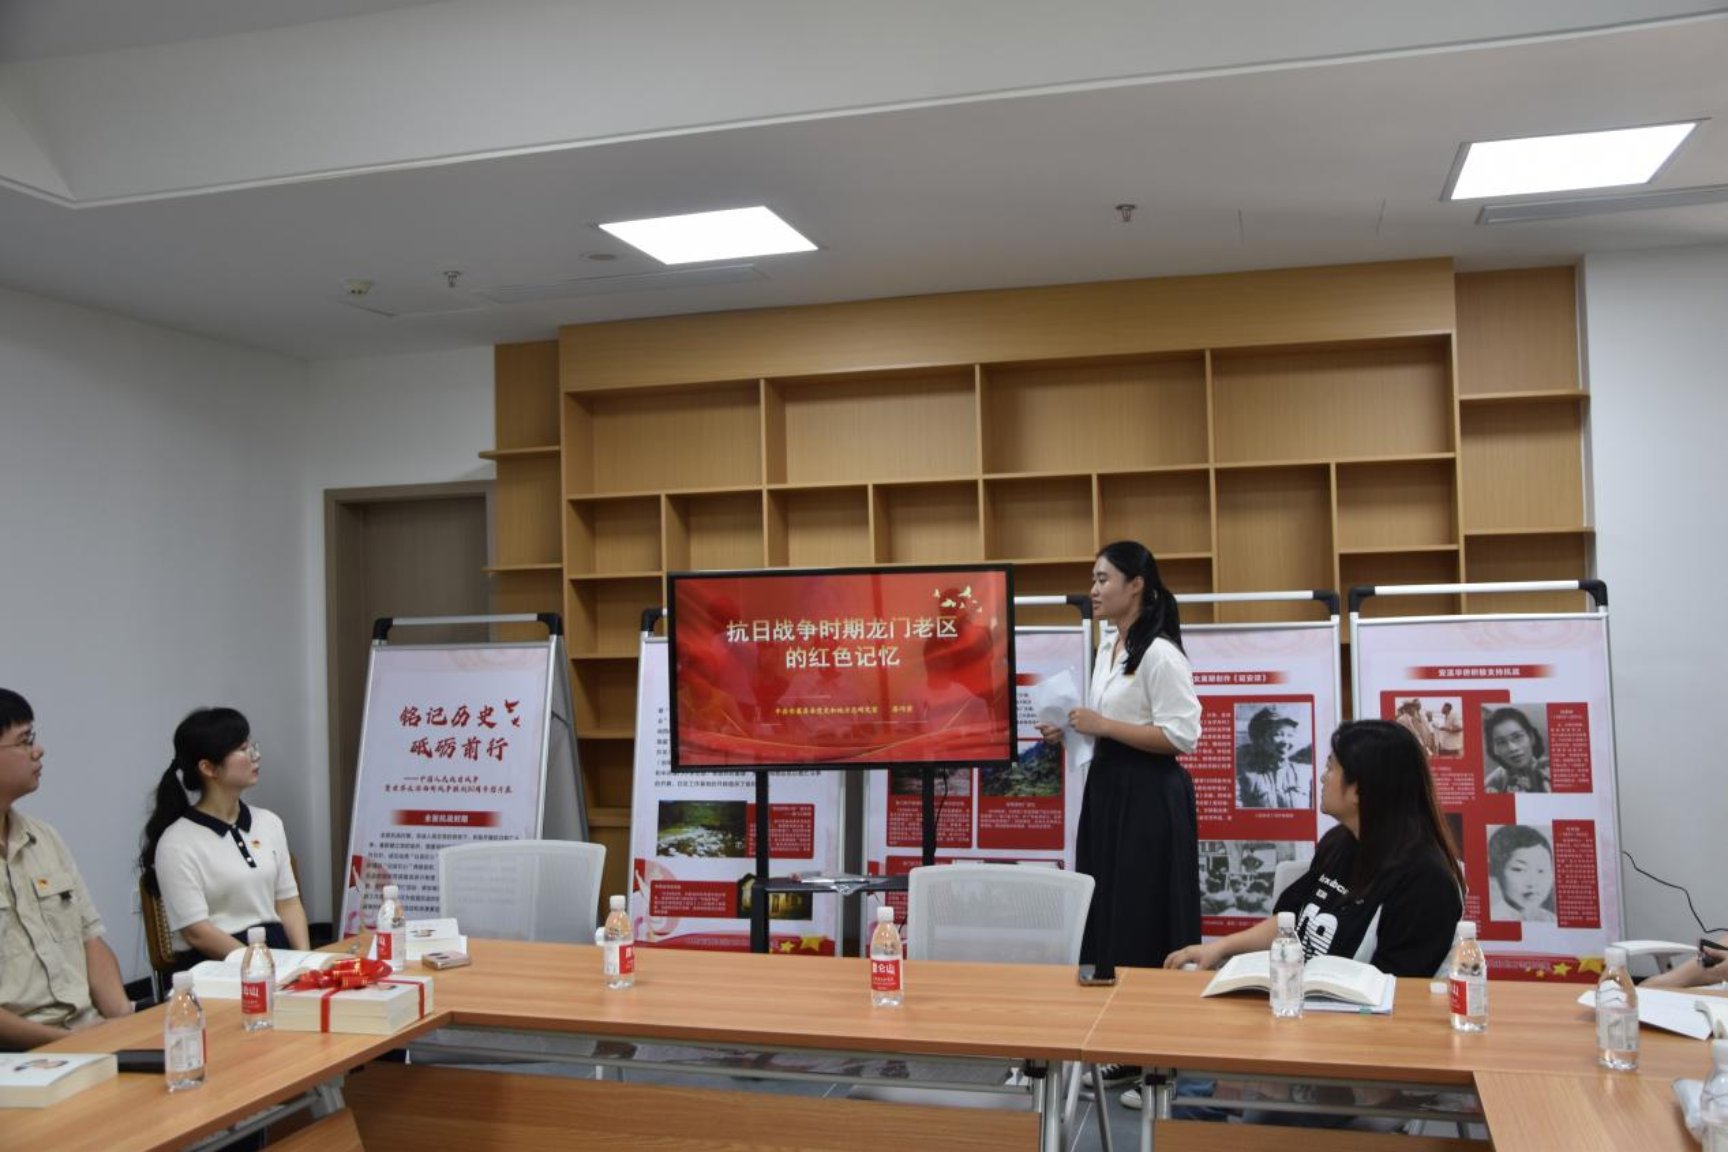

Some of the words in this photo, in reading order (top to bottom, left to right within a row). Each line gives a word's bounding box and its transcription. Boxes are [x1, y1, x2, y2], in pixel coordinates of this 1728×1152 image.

[727, 616, 958, 642] 抗日战争时期龙门老区
[786, 646, 901, 669] 的红色记忆
[400, 705, 498, 728] 铭记历史
[410, 736, 508, 761] 砥砺前行
